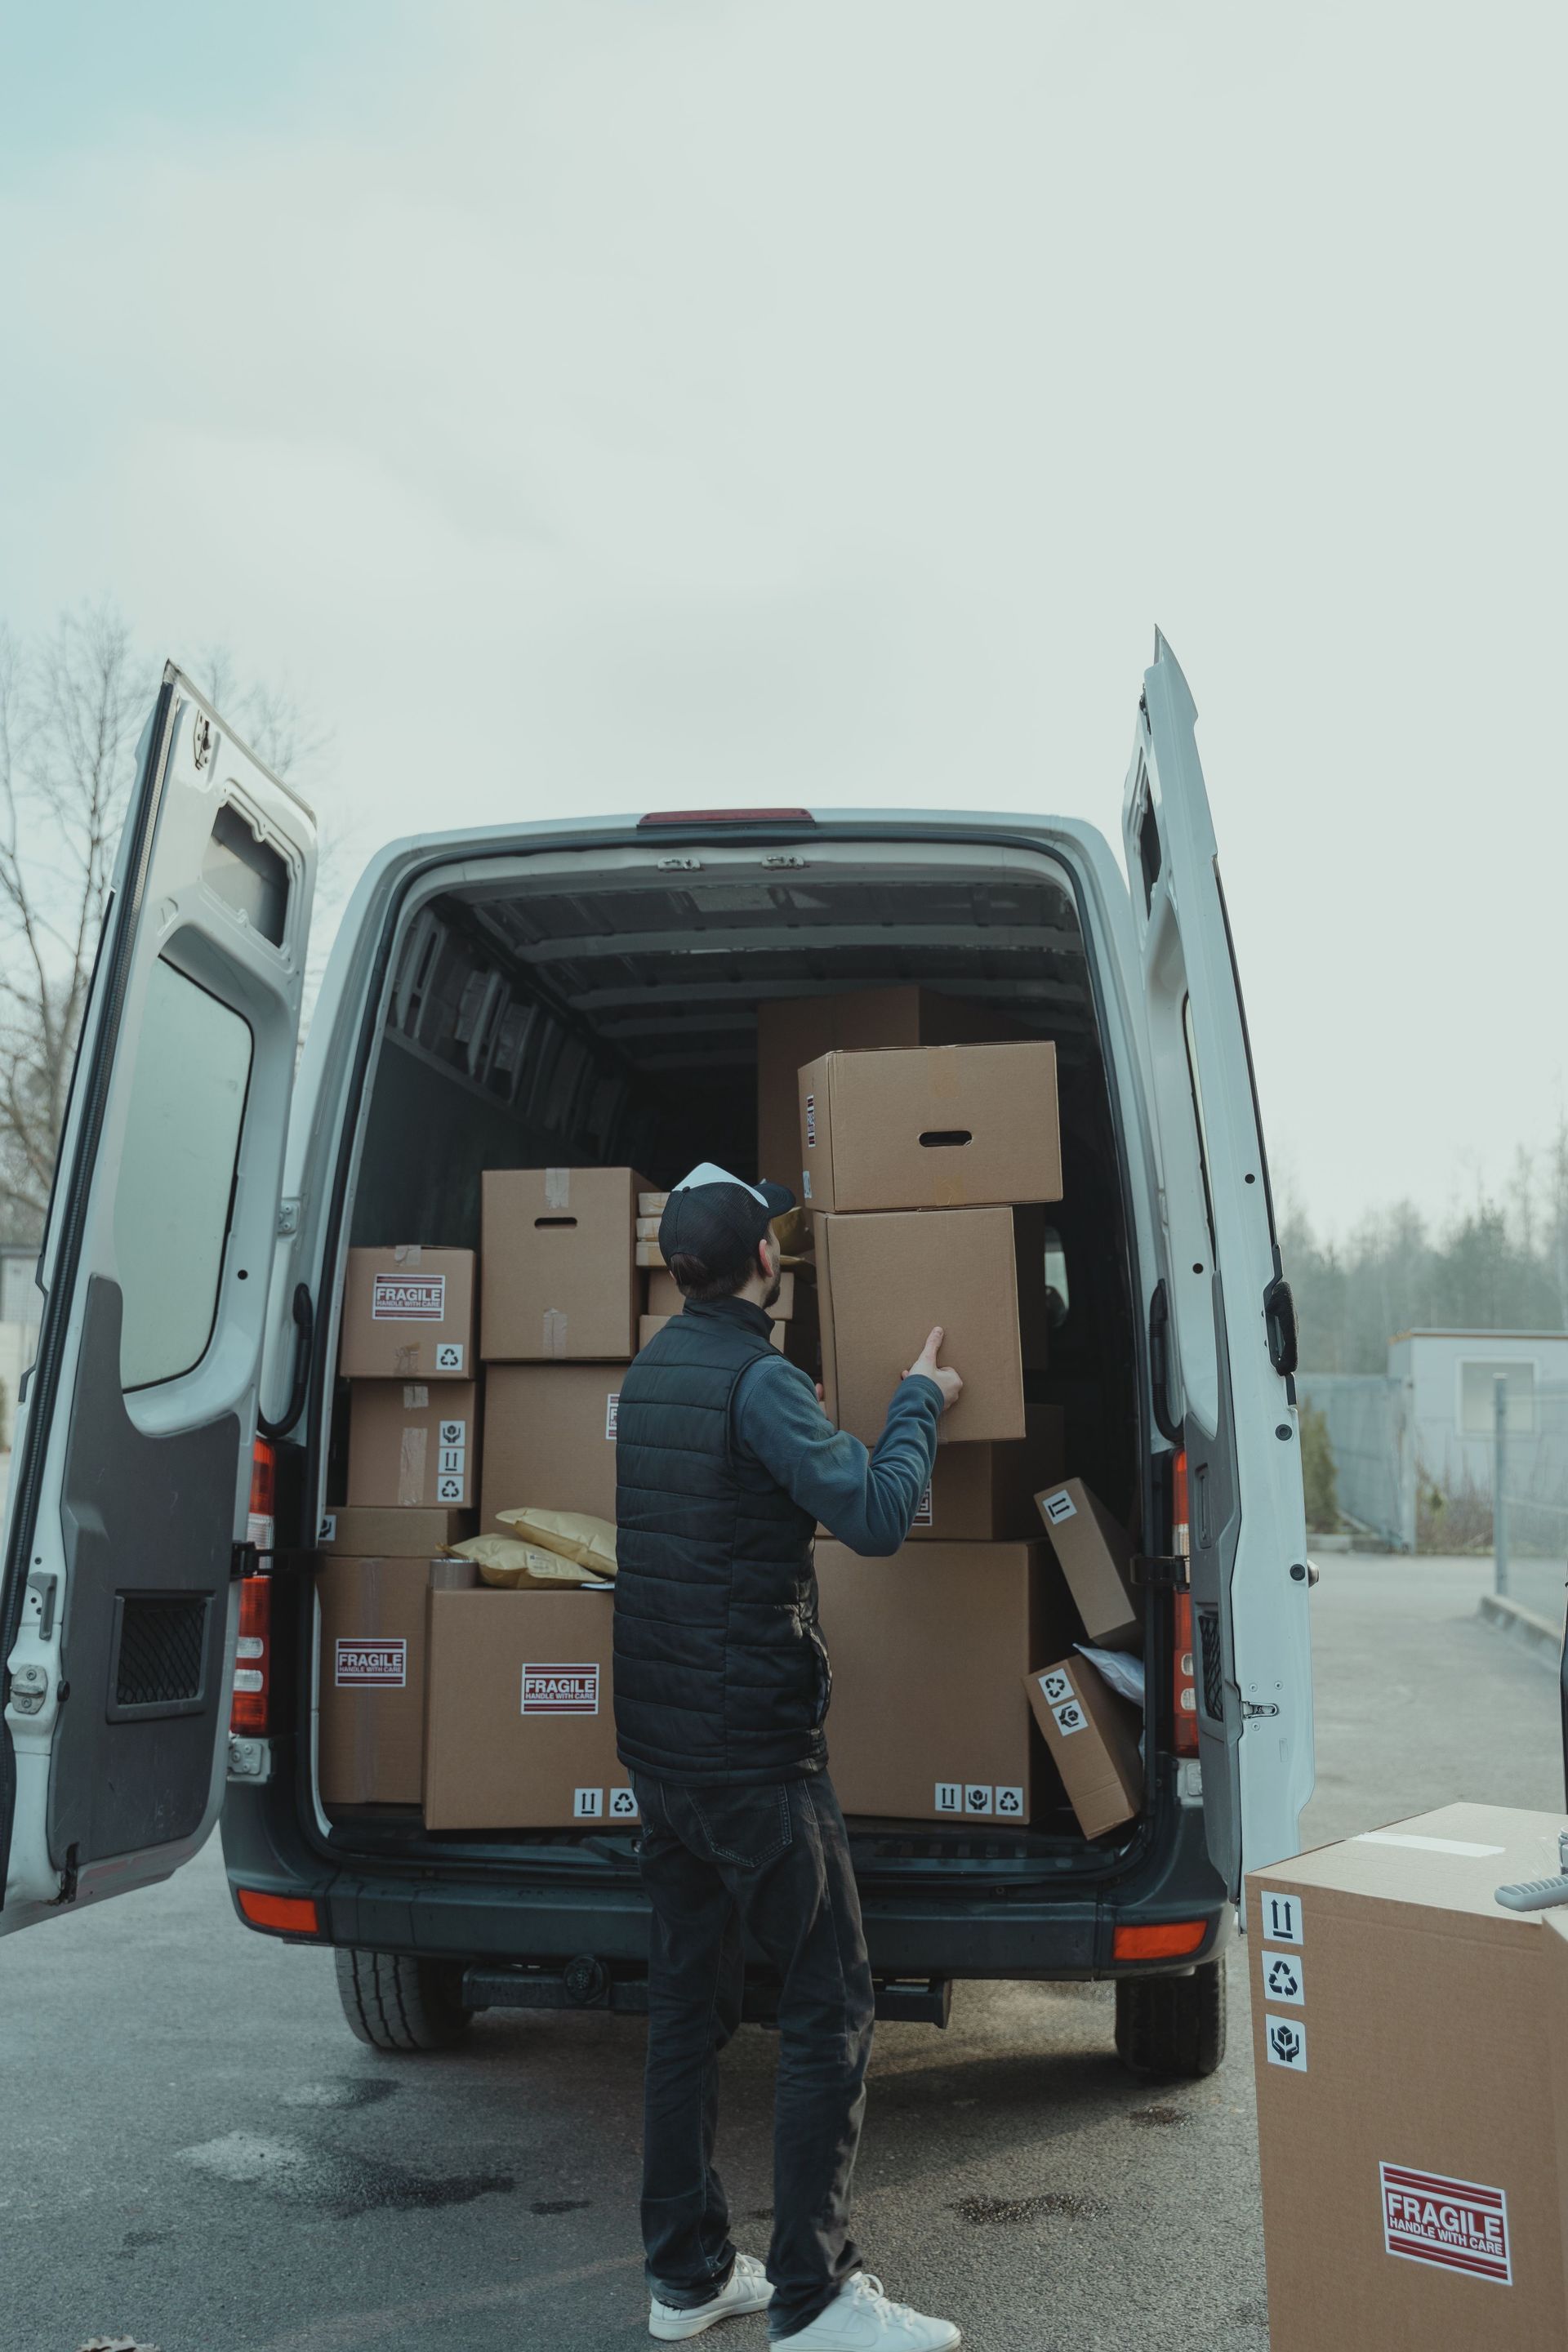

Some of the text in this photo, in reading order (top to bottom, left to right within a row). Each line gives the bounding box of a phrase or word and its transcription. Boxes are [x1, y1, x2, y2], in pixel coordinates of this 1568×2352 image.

[376, 1288, 441, 1302] FRAGILE
[339, 1654, 403, 1667] FRAGILE
[525, 1679, 595, 1693] FRAGILE
[1388, 2192, 1503, 2243] FRAGILE
[1389, 2216, 1503, 2256] HANDLE WITH CARE
